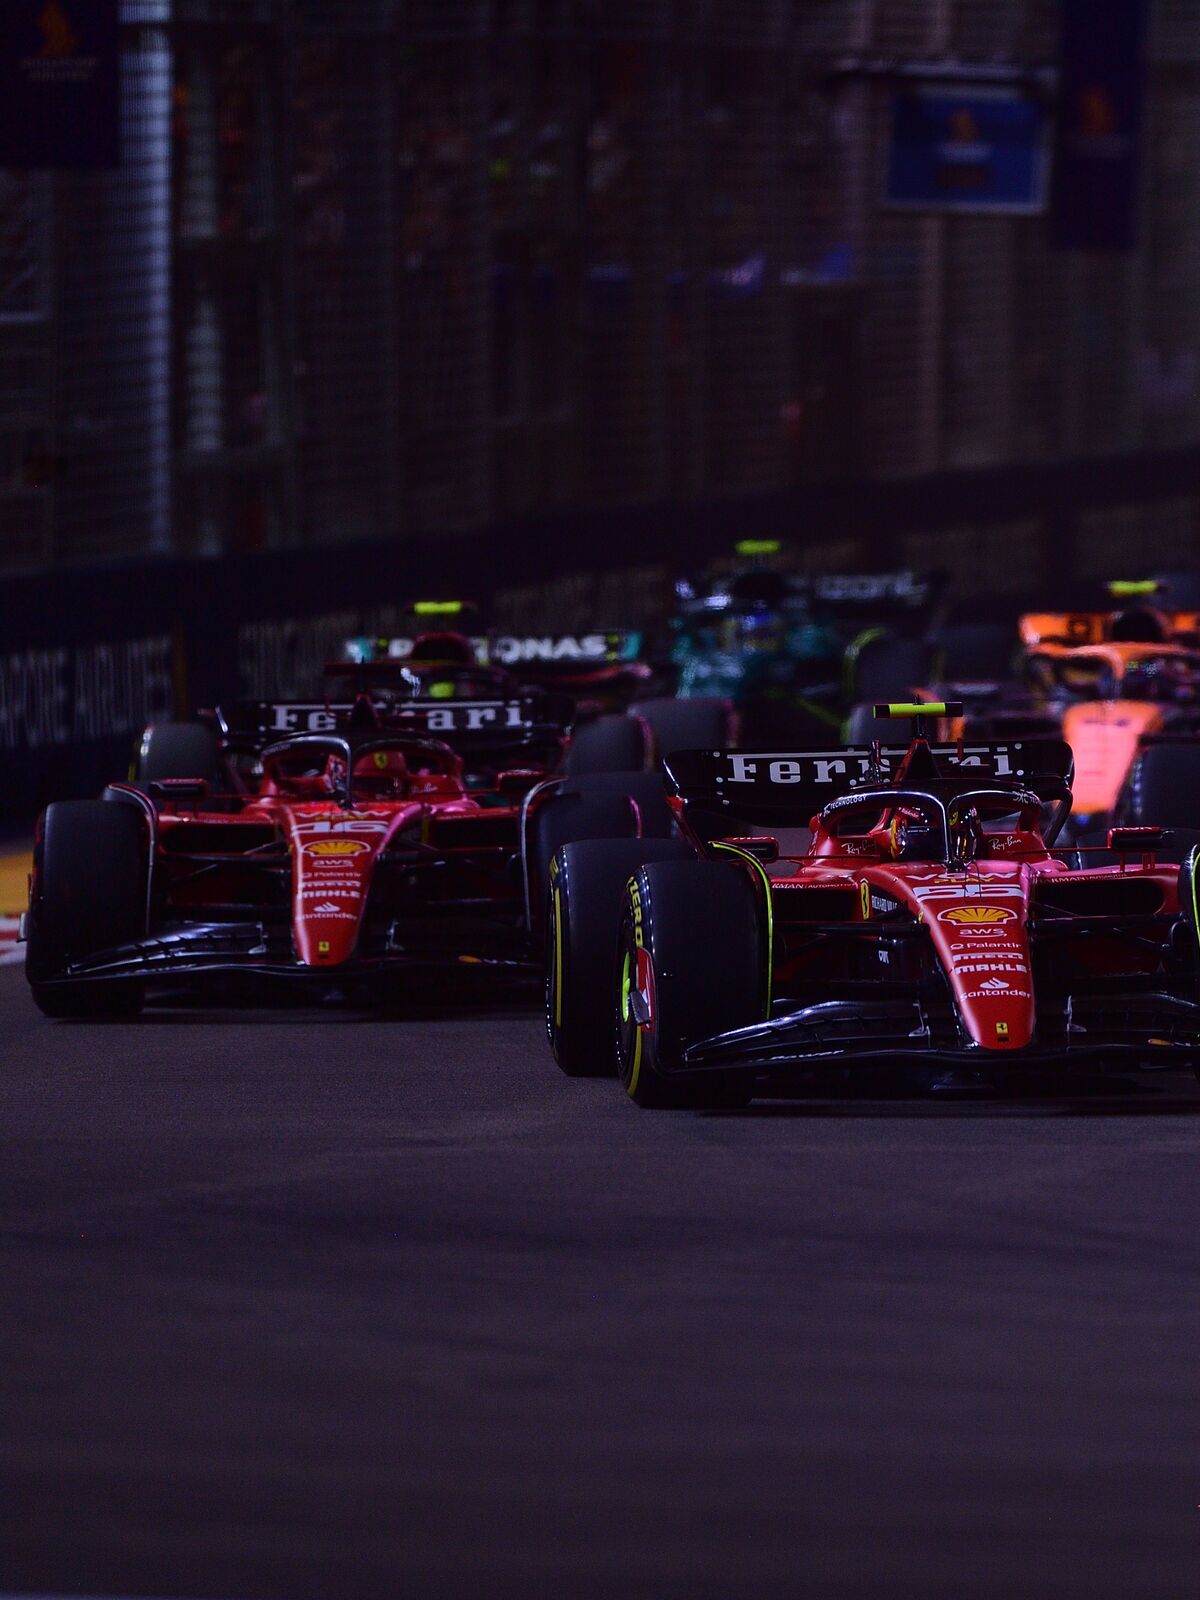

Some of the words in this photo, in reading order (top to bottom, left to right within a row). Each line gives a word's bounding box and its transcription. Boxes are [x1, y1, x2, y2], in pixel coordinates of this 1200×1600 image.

[387, 635, 608, 664] PONAS
[271, 700, 522, 731] Feari
[727, 747, 1013, 784] Ferri
[955, 964, 1027, 975] MAHLE
